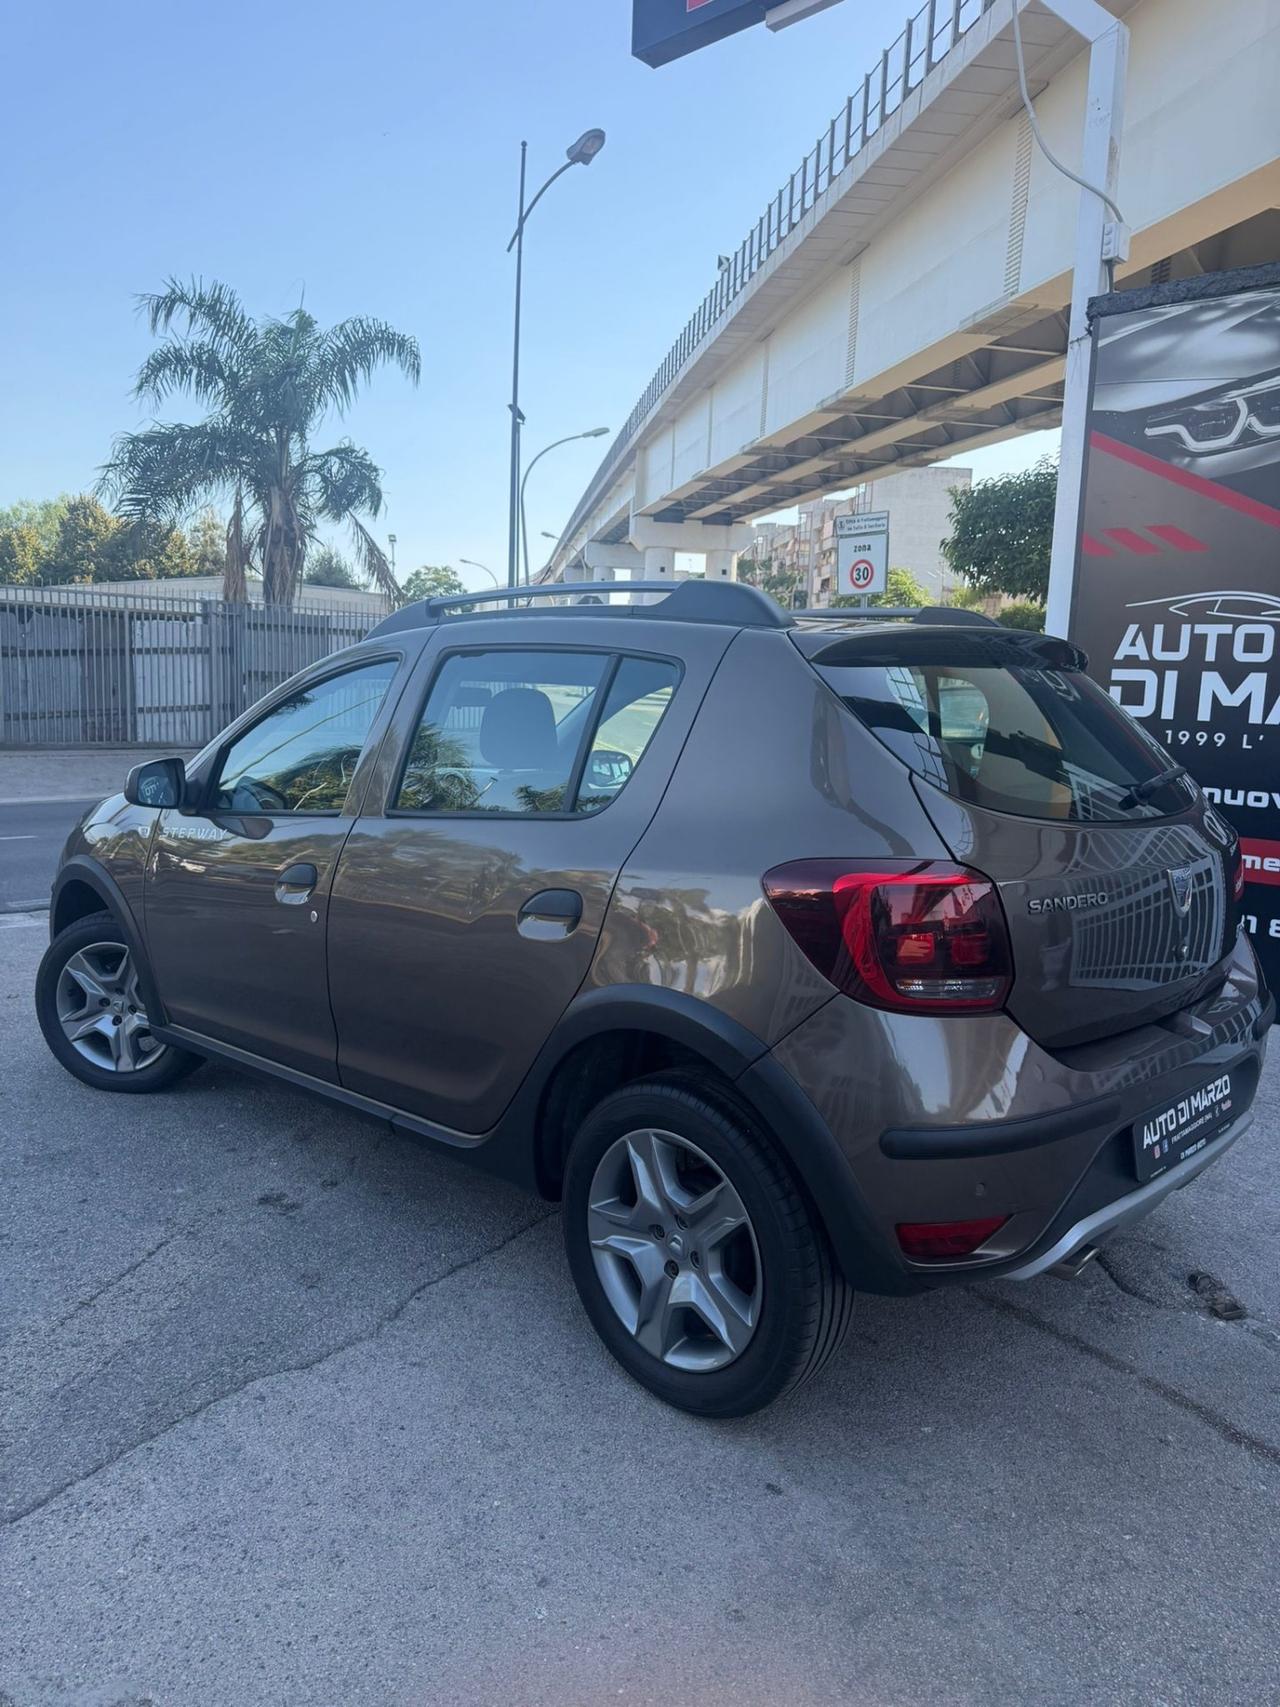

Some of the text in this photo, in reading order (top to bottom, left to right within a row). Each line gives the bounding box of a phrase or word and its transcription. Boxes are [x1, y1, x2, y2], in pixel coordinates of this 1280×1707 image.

[853, 544, 872, 553] zona
[855, 567, 869, 582] 30
[1113, 623, 1275, 663] AUTO
[1109, 668, 1178, 720] DI
[1165, 729, 1226, 747] 1999
[162, 826, 227, 840] STEPWAY
[1028, 892, 1109, 915] SANDERO
[1143, 1107, 1177, 1149] AUTO
[1177, 1098, 1190, 1126] DI
[1190, 1074, 1231, 1116] MARZO
